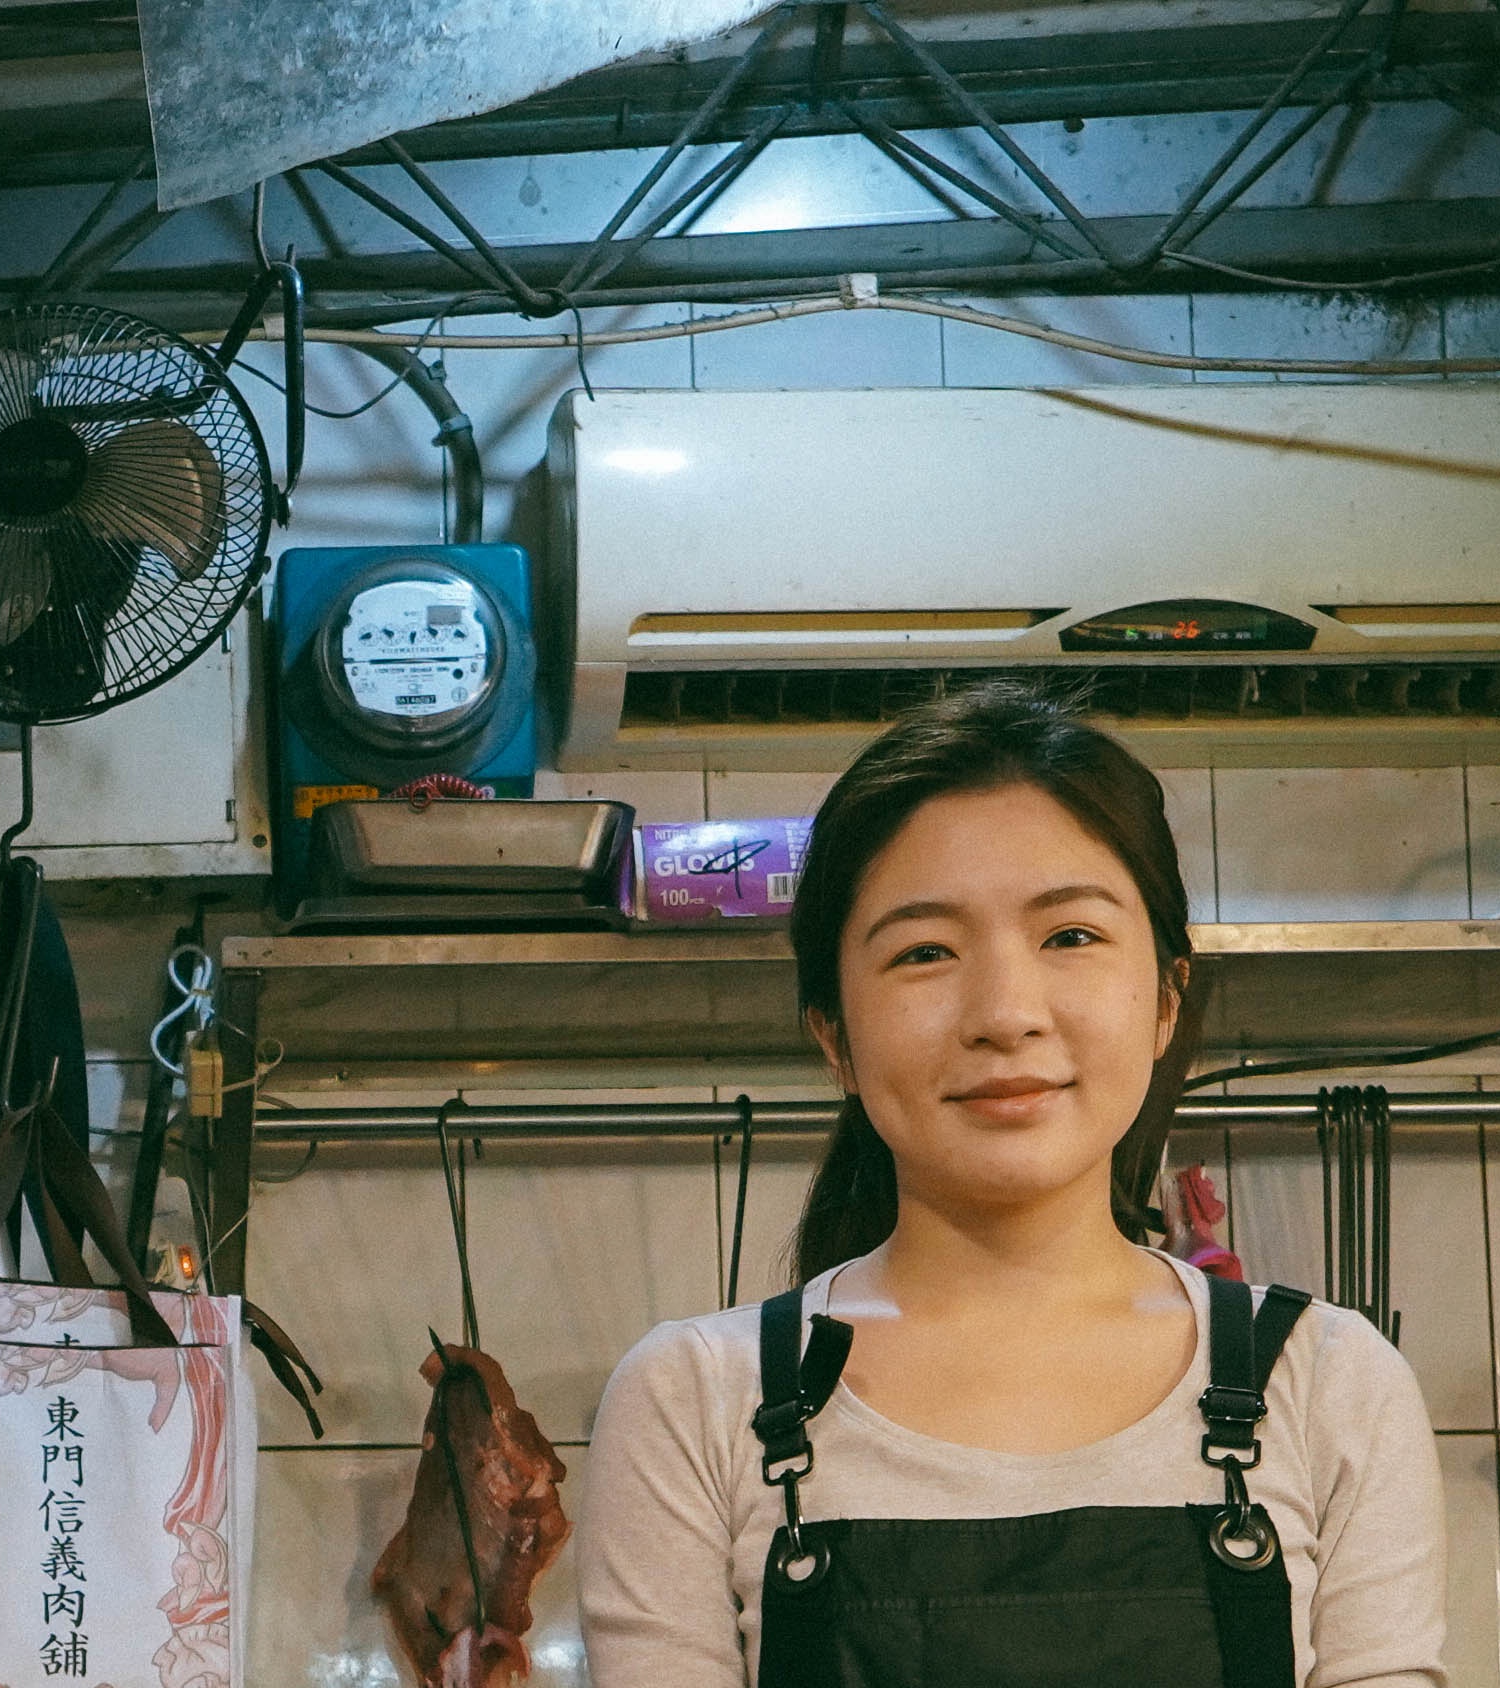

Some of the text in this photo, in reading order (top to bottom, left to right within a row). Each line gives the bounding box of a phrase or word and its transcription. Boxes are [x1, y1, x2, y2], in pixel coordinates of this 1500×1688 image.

[1172, 620, 1200, 639] 26
[37, 1394, 88, 1679] 東門信義肉舖
